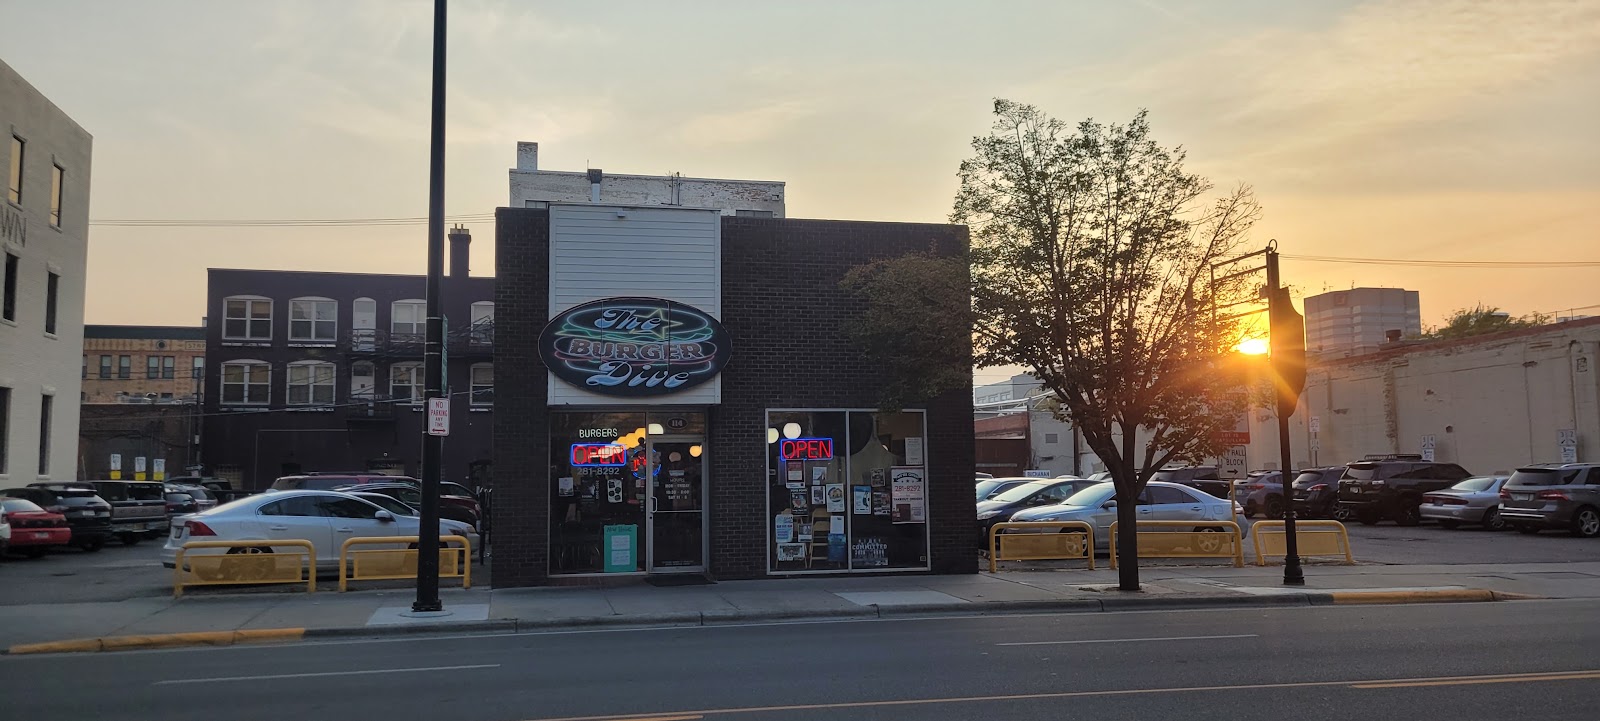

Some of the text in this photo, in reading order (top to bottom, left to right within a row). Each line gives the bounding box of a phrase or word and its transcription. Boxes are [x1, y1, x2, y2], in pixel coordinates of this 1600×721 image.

[594, 308, 662, 330] The
[570, 339, 704, 361] BURGER
[586, 361, 690, 388] Dive
[578, 428, 618, 438] BURGERS
[574, 446, 625, 464] OPEN
[782, 440, 831, 459] OPEN
[577, 467, 620, 476] 281-8292
